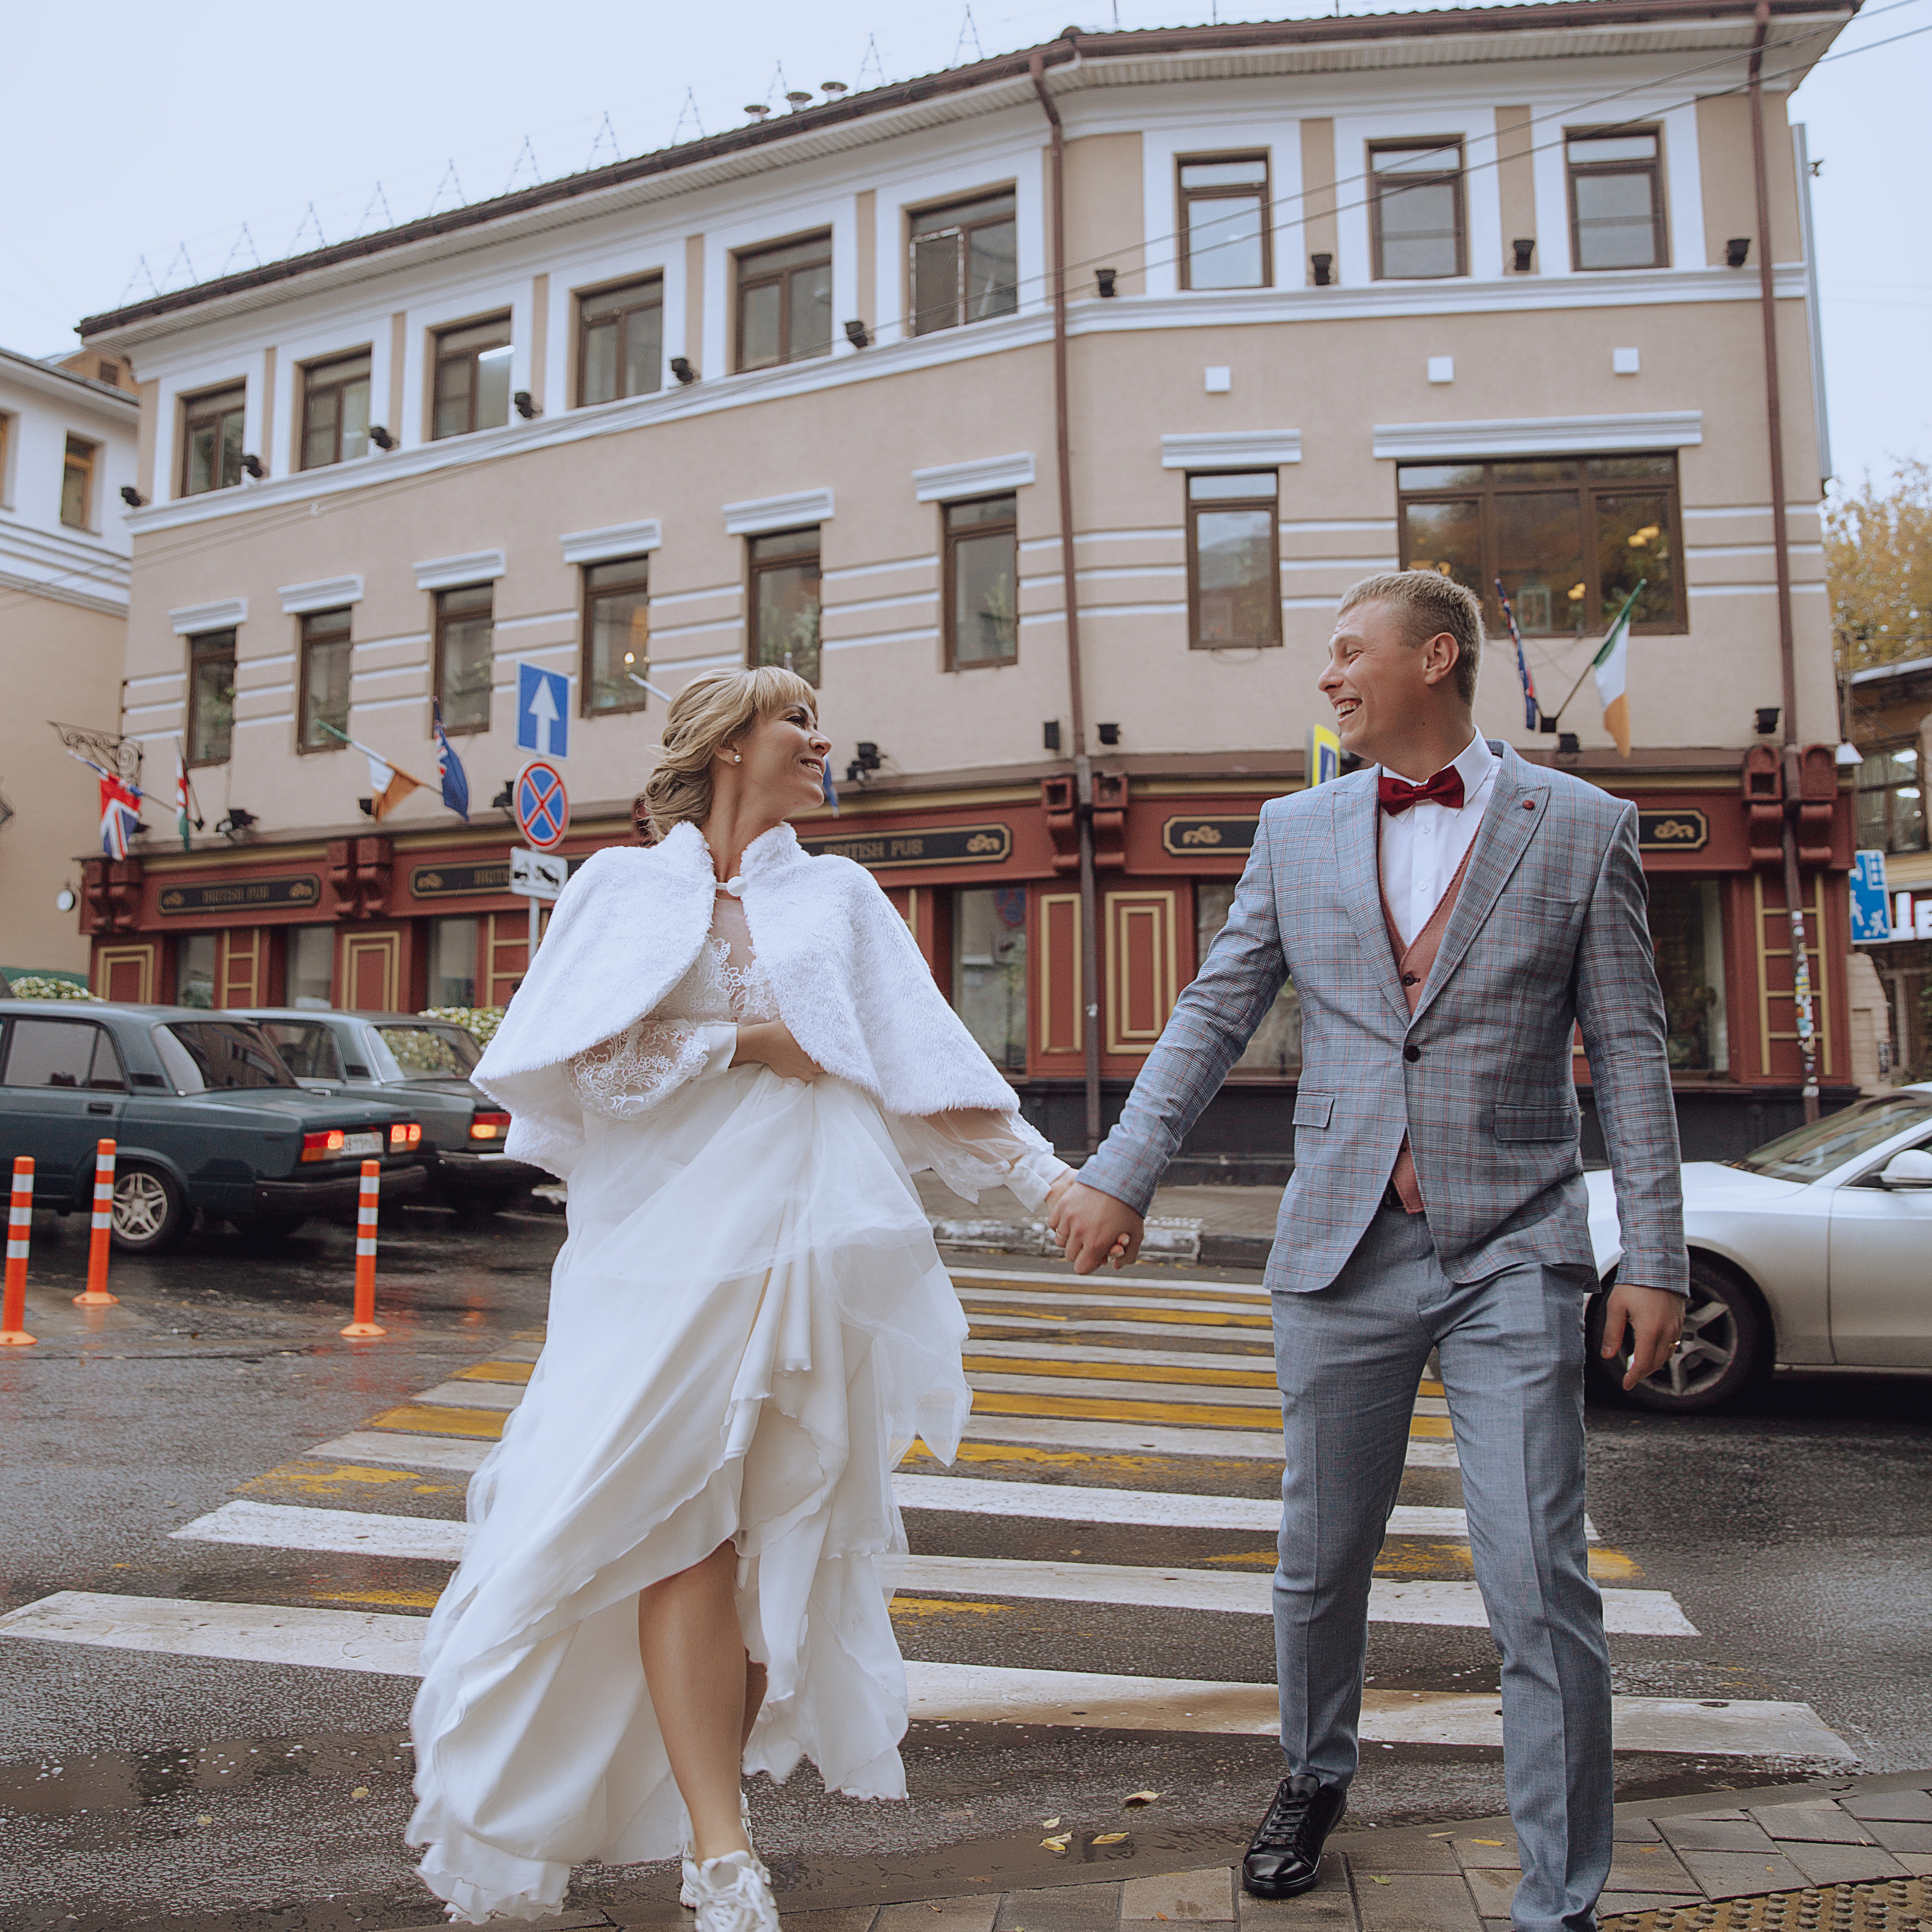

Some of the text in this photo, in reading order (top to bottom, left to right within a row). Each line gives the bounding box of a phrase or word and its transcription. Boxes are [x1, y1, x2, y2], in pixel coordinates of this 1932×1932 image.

[891, 838, 924, 857] PUB
[202, 885, 270, 903] BRITISH PUB
